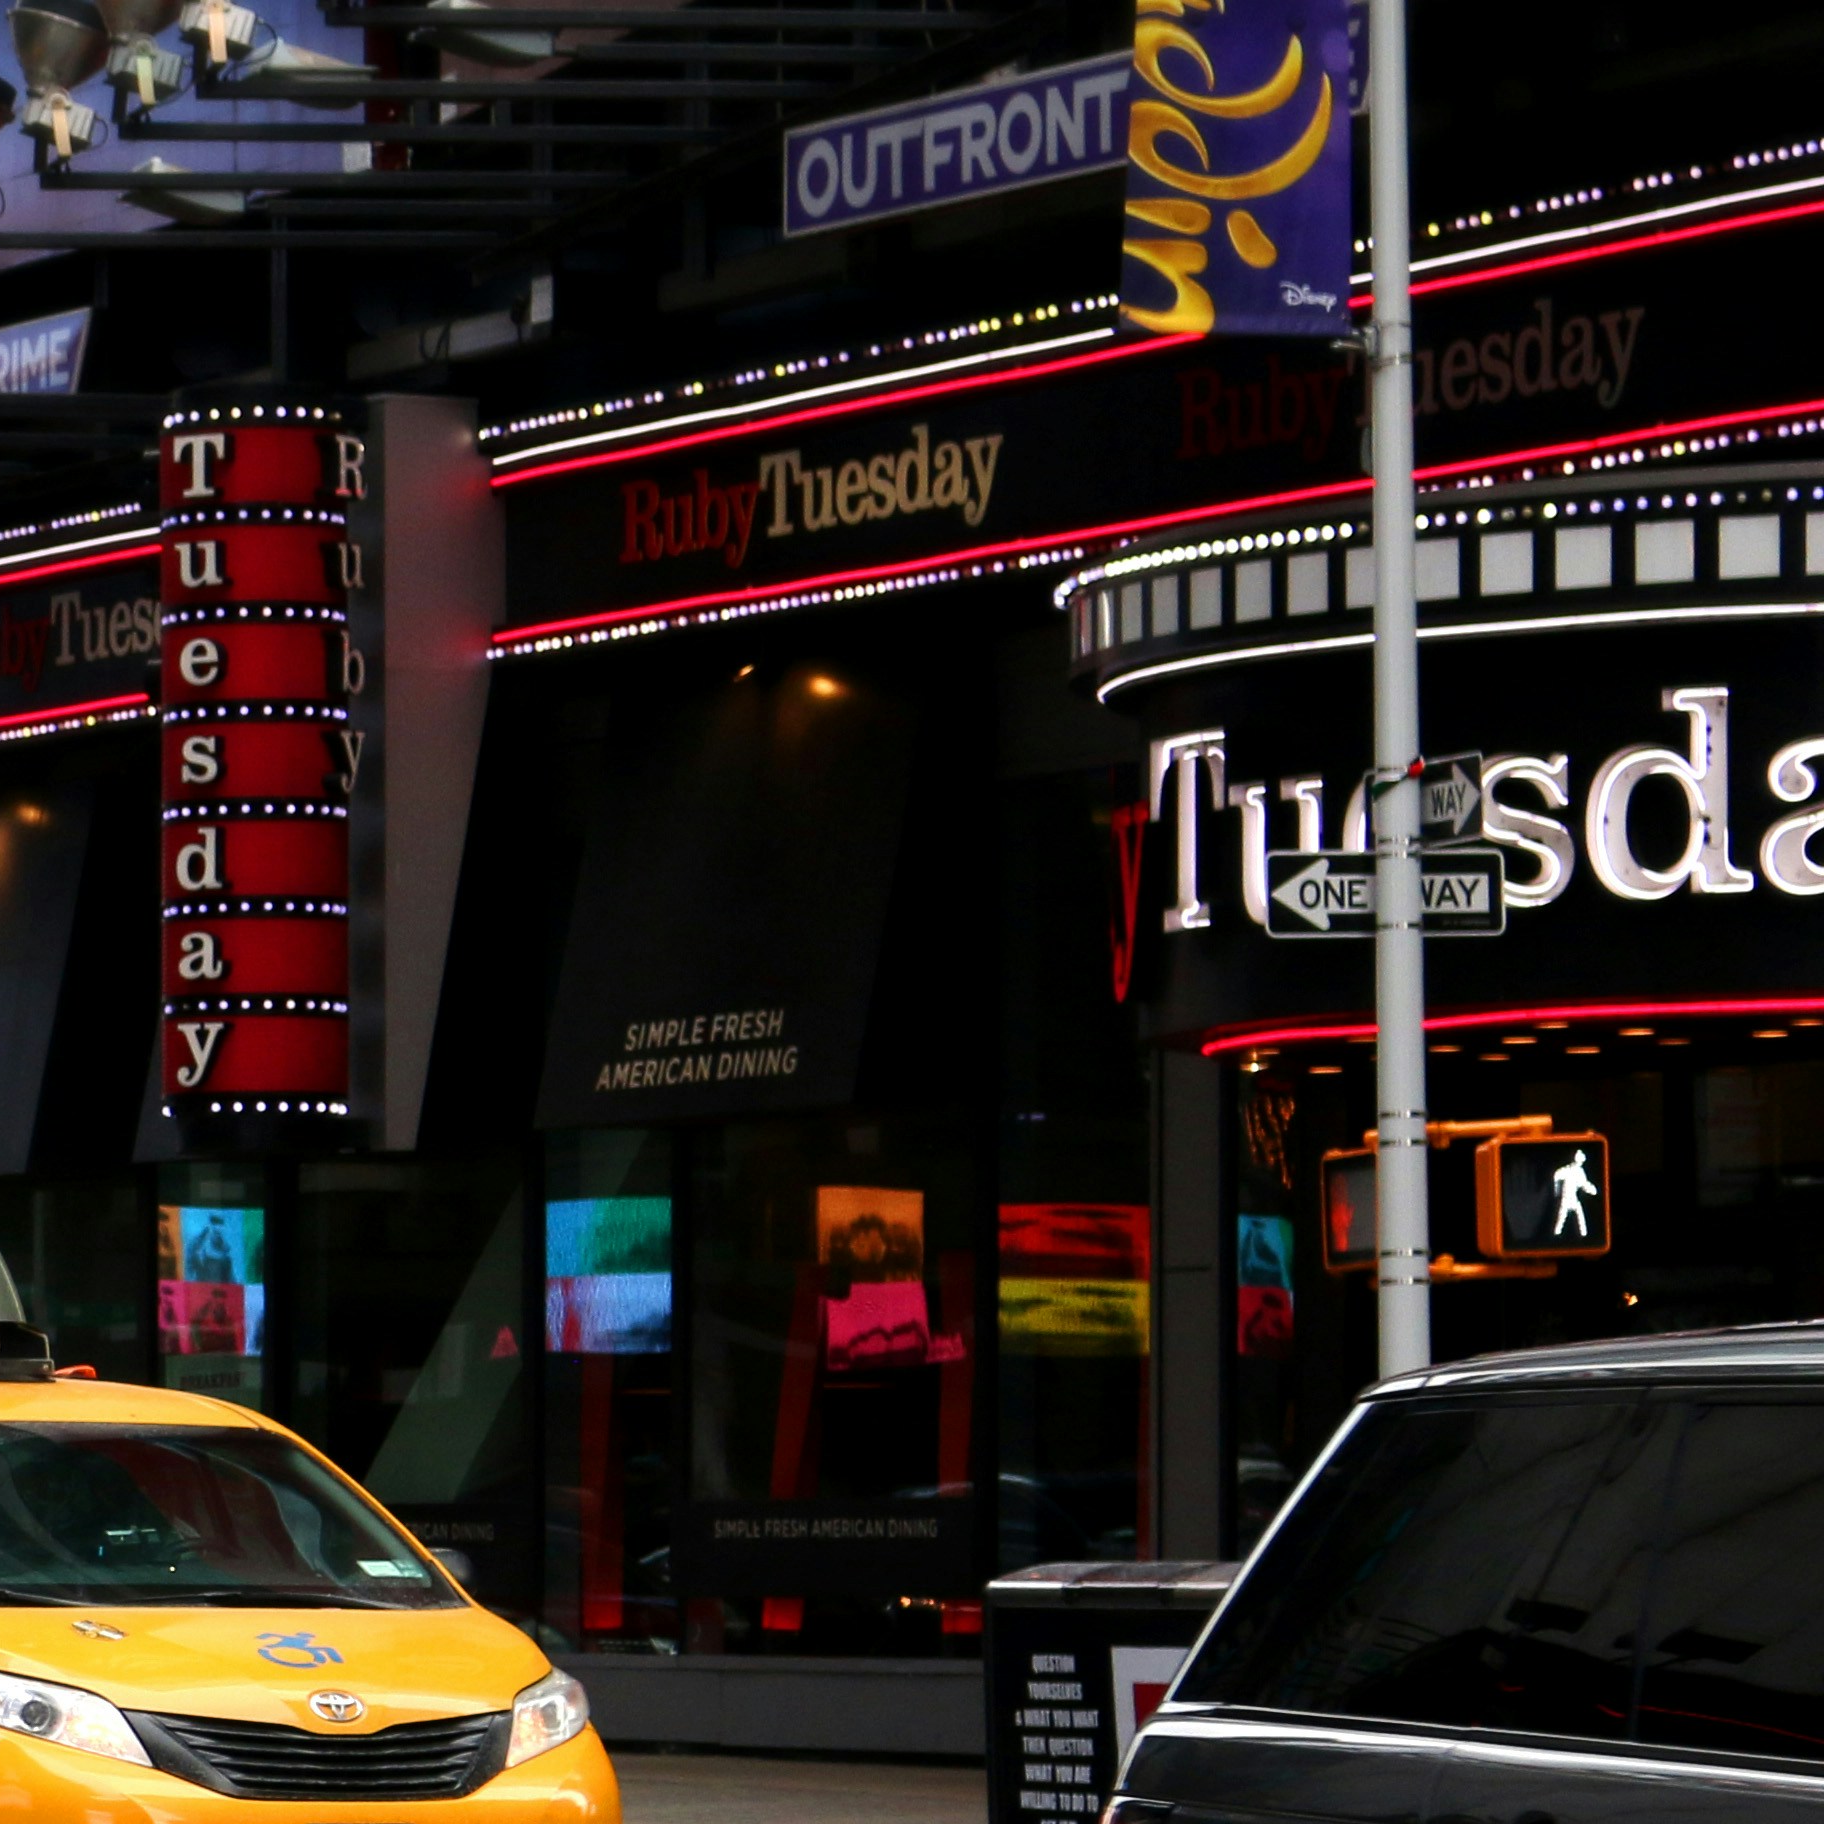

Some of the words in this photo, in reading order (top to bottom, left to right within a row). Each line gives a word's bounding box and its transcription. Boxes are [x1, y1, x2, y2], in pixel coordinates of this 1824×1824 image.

[796, 69, 1130, 218] OUTFRONT
[1279, 280, 1338, 313] Disney
[619, 470, 762, 568] Ruby
[759, 424, 1004, 538] Tuesday
[51, 589, 162, 668] Tues
[1431, 784, 1467, 818] WAY
[1298, 878, 1369, 911] ONE
[625, 1016, 707, 1052] SIMPLE
[710, 1008, 784, 1042] FRESH
[595, 1053, 713, 1091] AMERICAN
[716, 1046, 798, 1081] DINING
[714, 1518, 760, 1539] SIMPLE
[764, 1518, 806, 1538] FRESH
[811, 1518, 884, 1538] AMERICAN
[887, 1517, 938, 1538] DINING
[1024, 1709, 1050, 1727] WHAT
[1053, 1709, 1071, 1728] YOU
[1072, 1709, 1099, 1728] WANT
